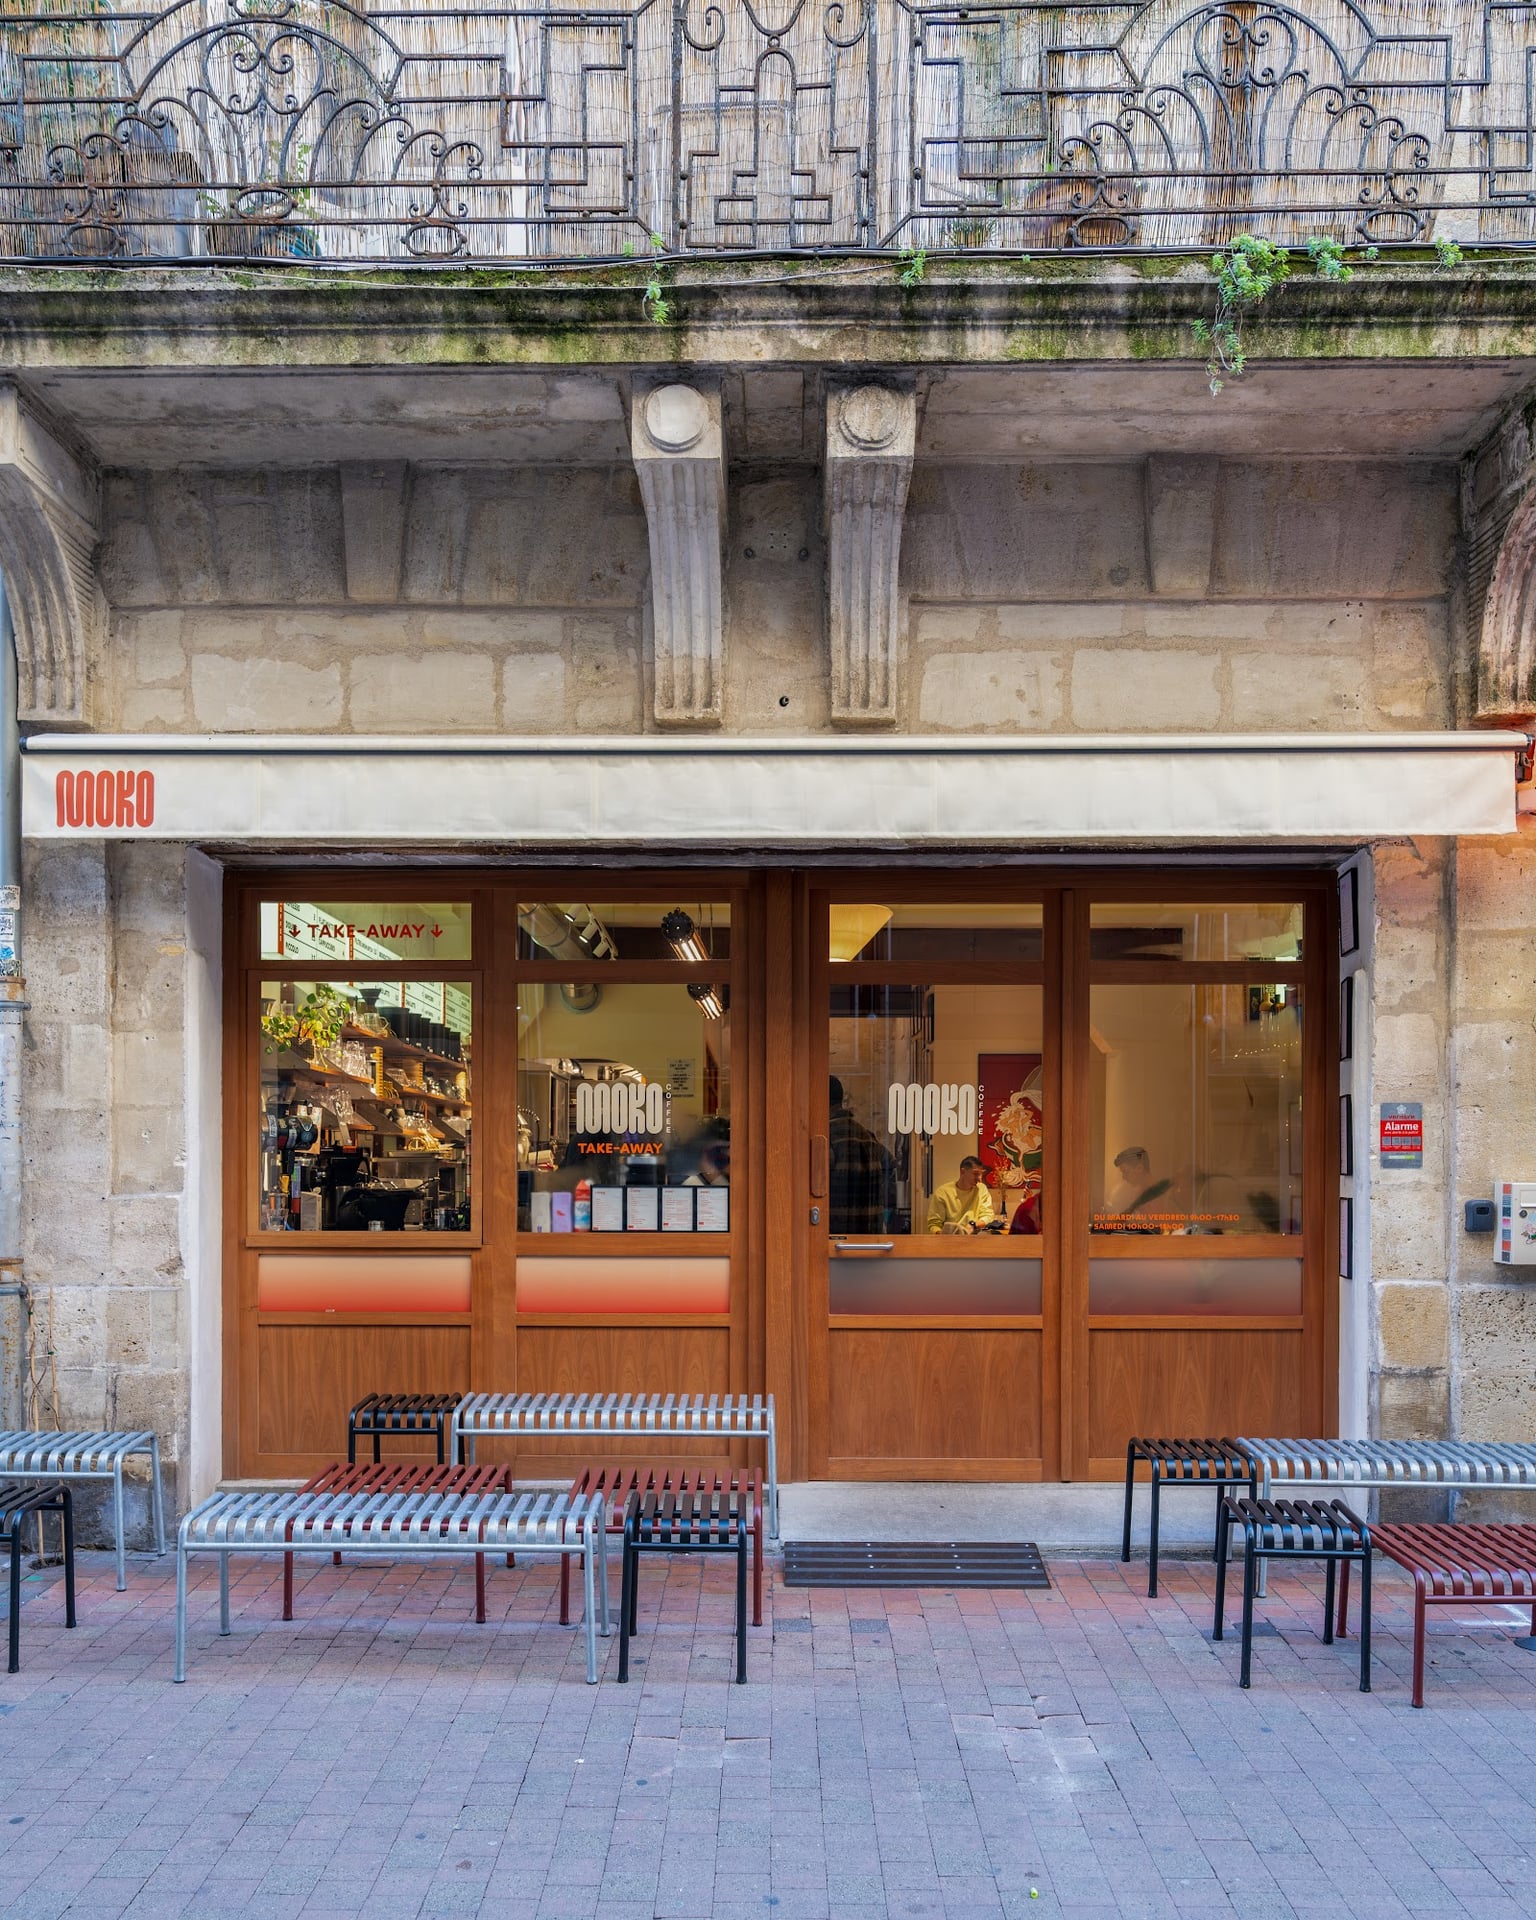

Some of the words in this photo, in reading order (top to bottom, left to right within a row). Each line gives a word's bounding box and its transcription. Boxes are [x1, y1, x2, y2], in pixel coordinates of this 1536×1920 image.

[56, 770, 154, 828] MOKO
[307, 924, 425, 938] TAKE-AWAY
[577, 1083, 663, 1134] MOKO
[888, 1083, 975, 1135] MOKO
[1385, 1121, 1419, 1131] Alarme
[577, 1142, 663, 1154] TAKE-AWAY
[1094, 1213, 1105, 1221] DU
[1107, 1213, 1134, 1221] MARDI
[1135, 1213, 1146, 1221] AU
[1149, 1213, 1188, 1221] VENDREDI
